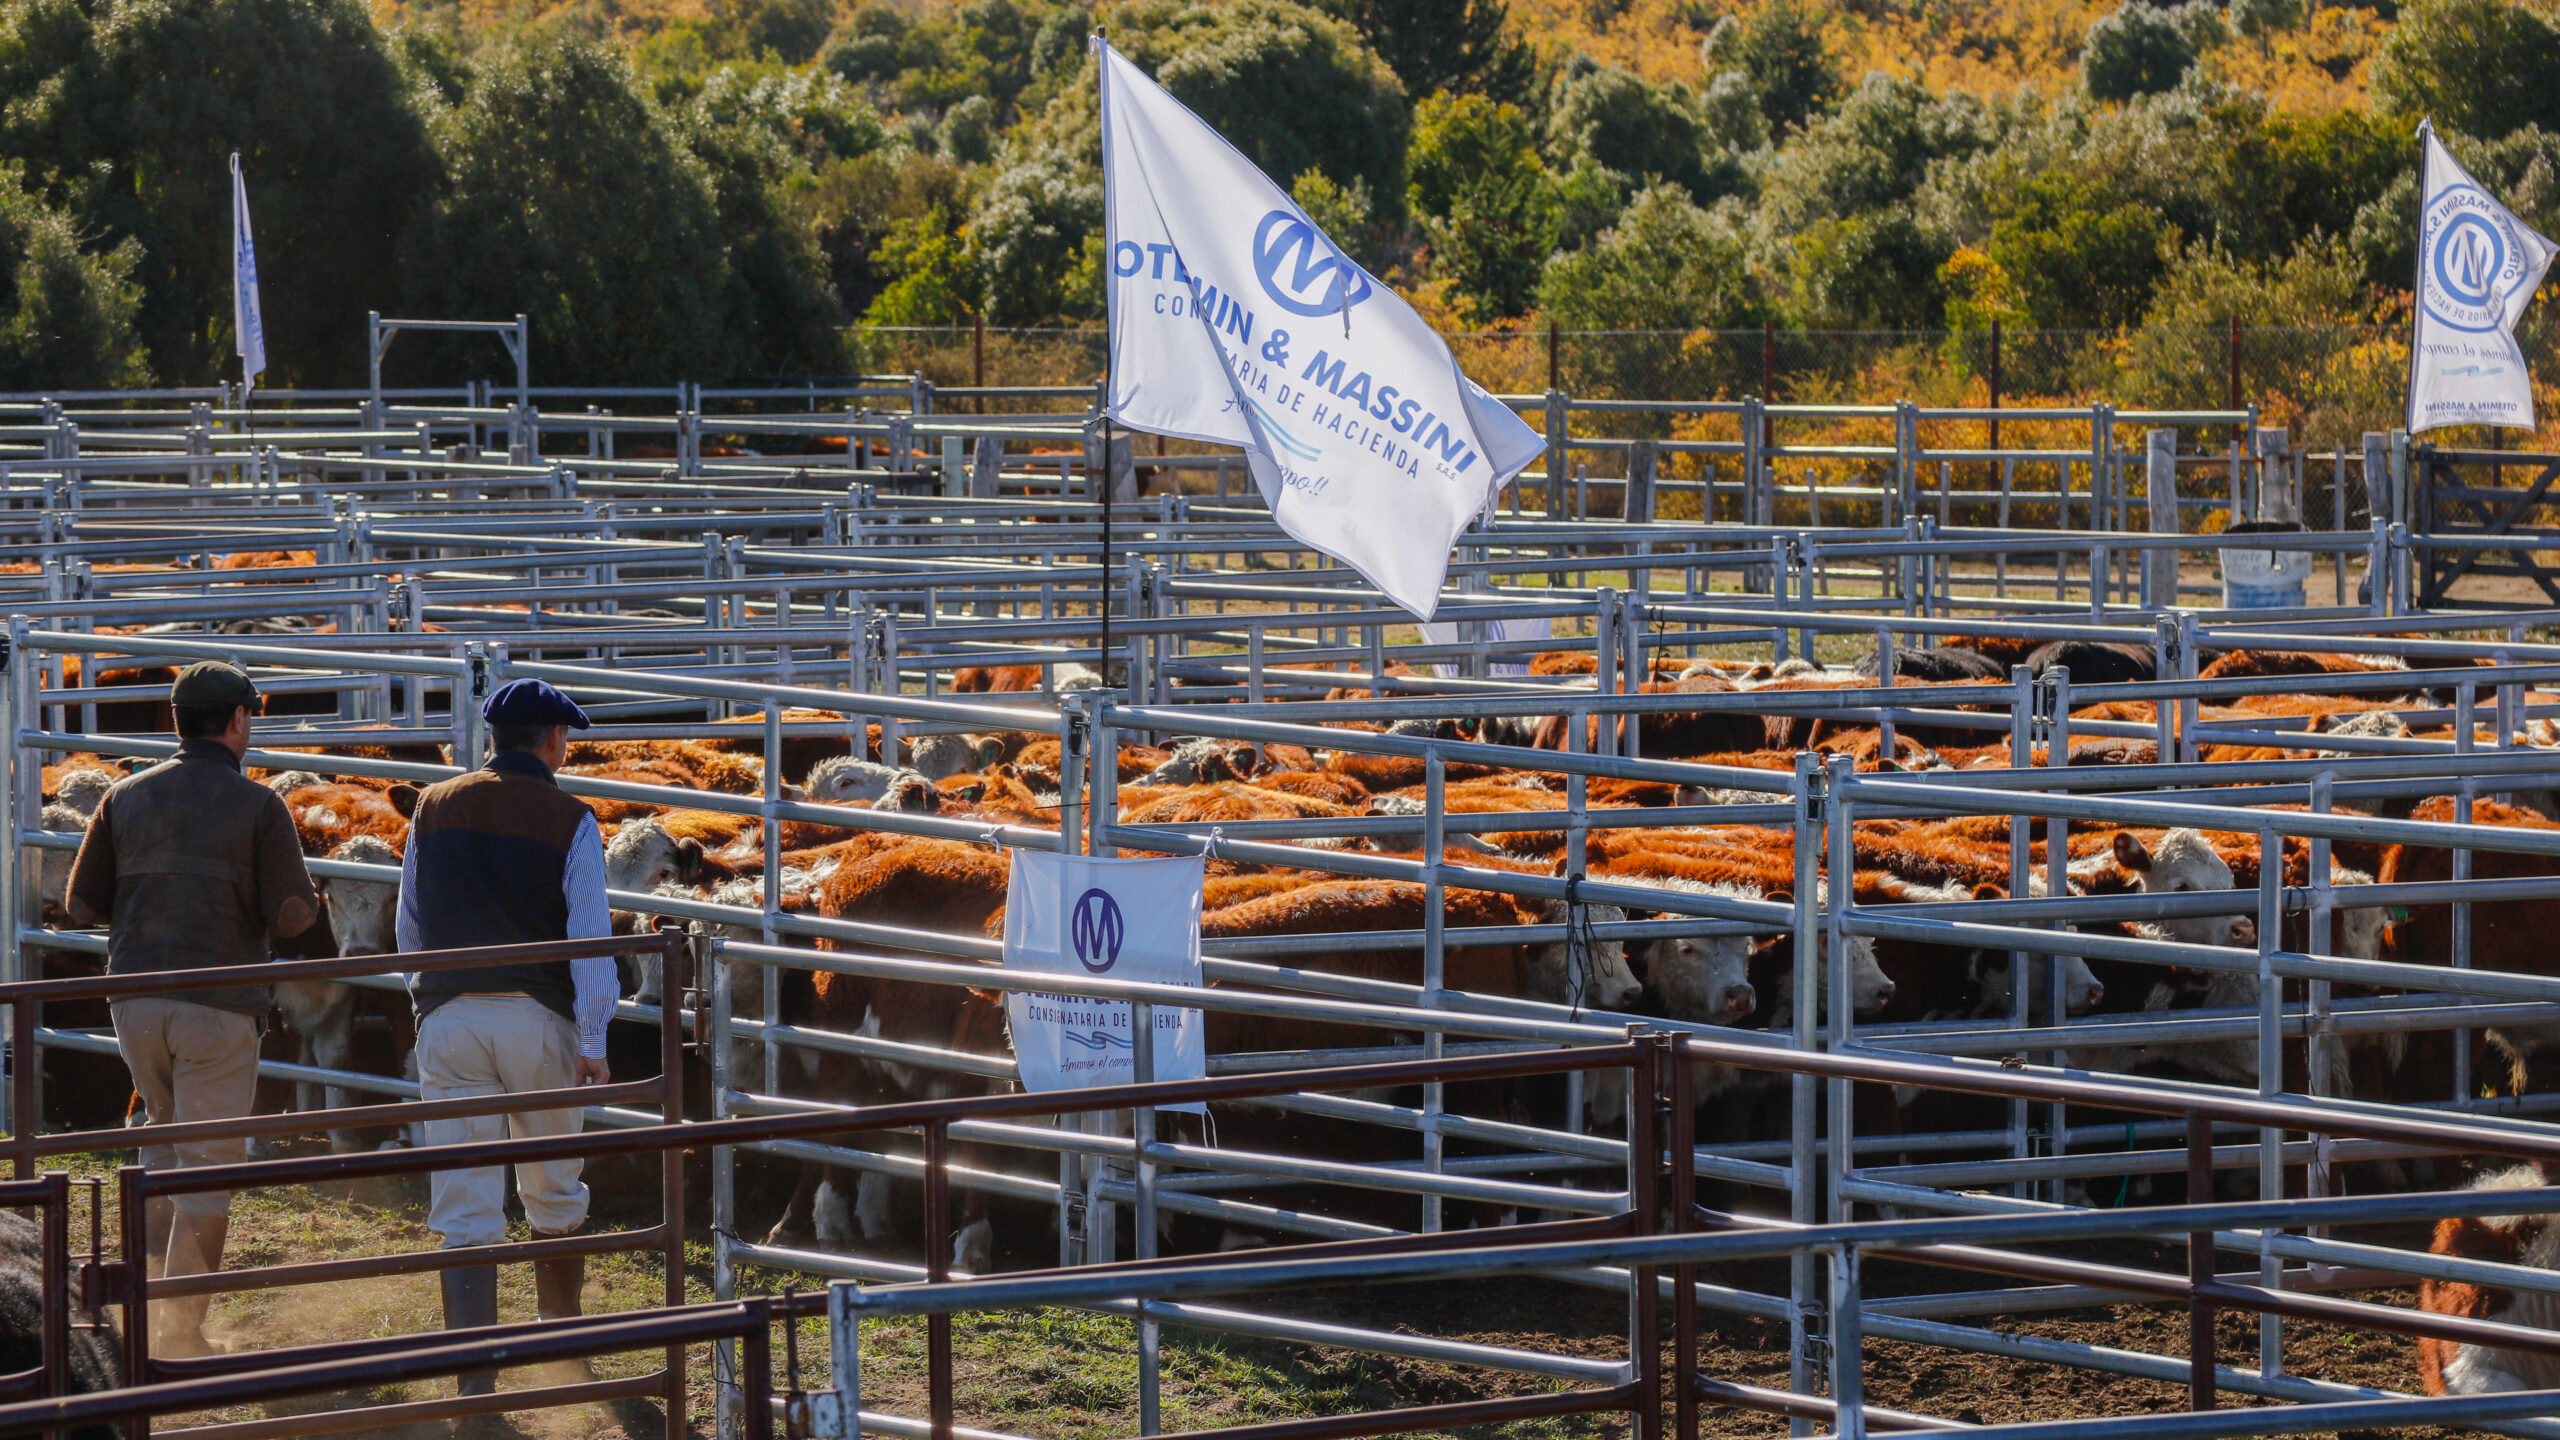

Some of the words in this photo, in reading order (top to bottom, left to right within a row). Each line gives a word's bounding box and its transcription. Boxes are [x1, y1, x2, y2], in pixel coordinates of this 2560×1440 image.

[1261, 329, 1290, 369] &
[1301, 350, 1477, 473] MASSINI
[1277, 384, 1305, 413] DE
[1312, 403, 1419, 479] HACIENDA
[1113, 1012, 1128, 1027] DE
